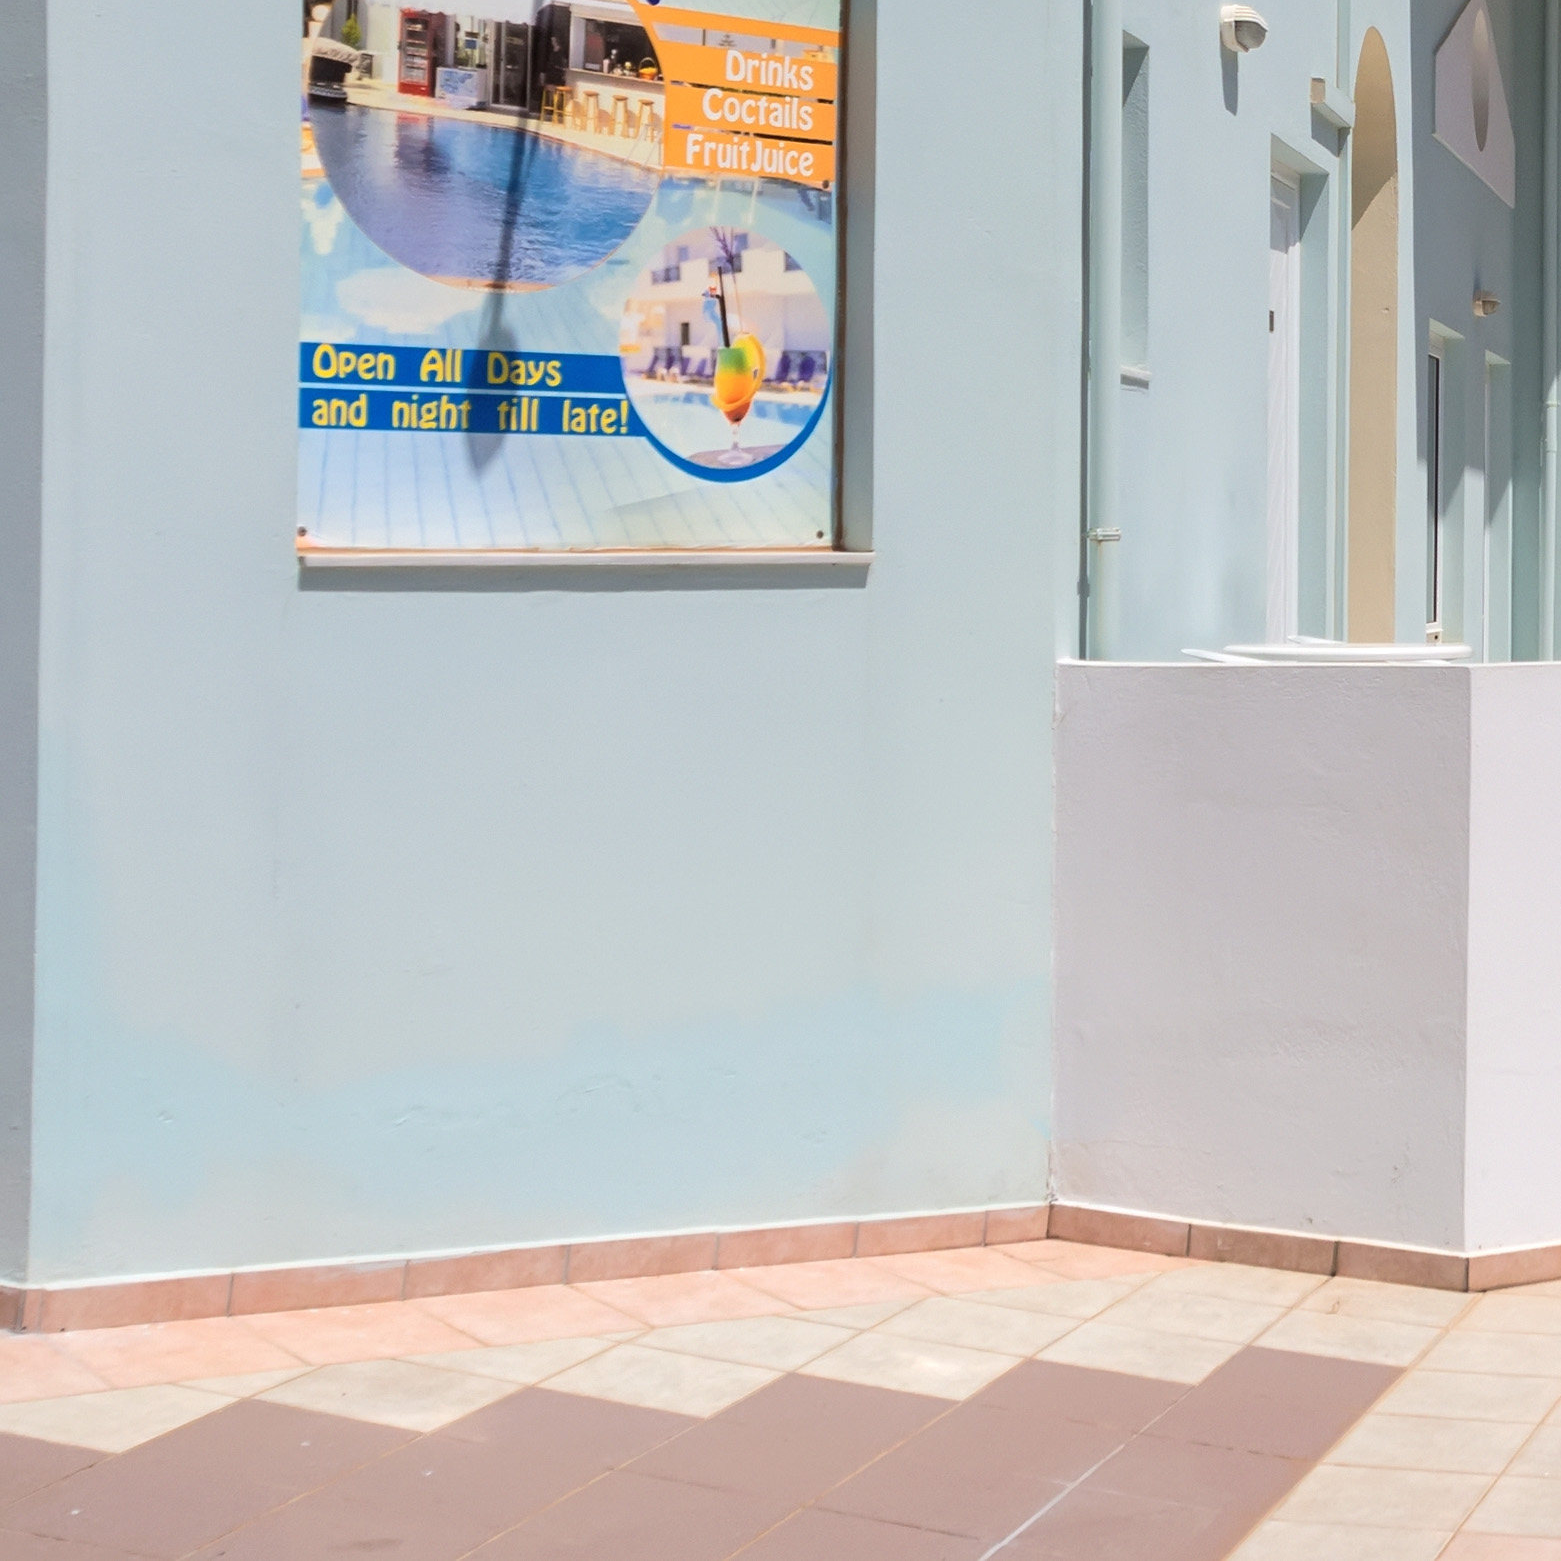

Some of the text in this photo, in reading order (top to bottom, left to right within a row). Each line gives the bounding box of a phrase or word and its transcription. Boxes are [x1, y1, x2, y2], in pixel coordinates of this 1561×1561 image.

[725, 49, 814, 90] Drinks
[702, 88, 813, 131] Coctails
[312, 344, 562, 386] Open All Days
[312, 394, 629, 434] and night till late!
